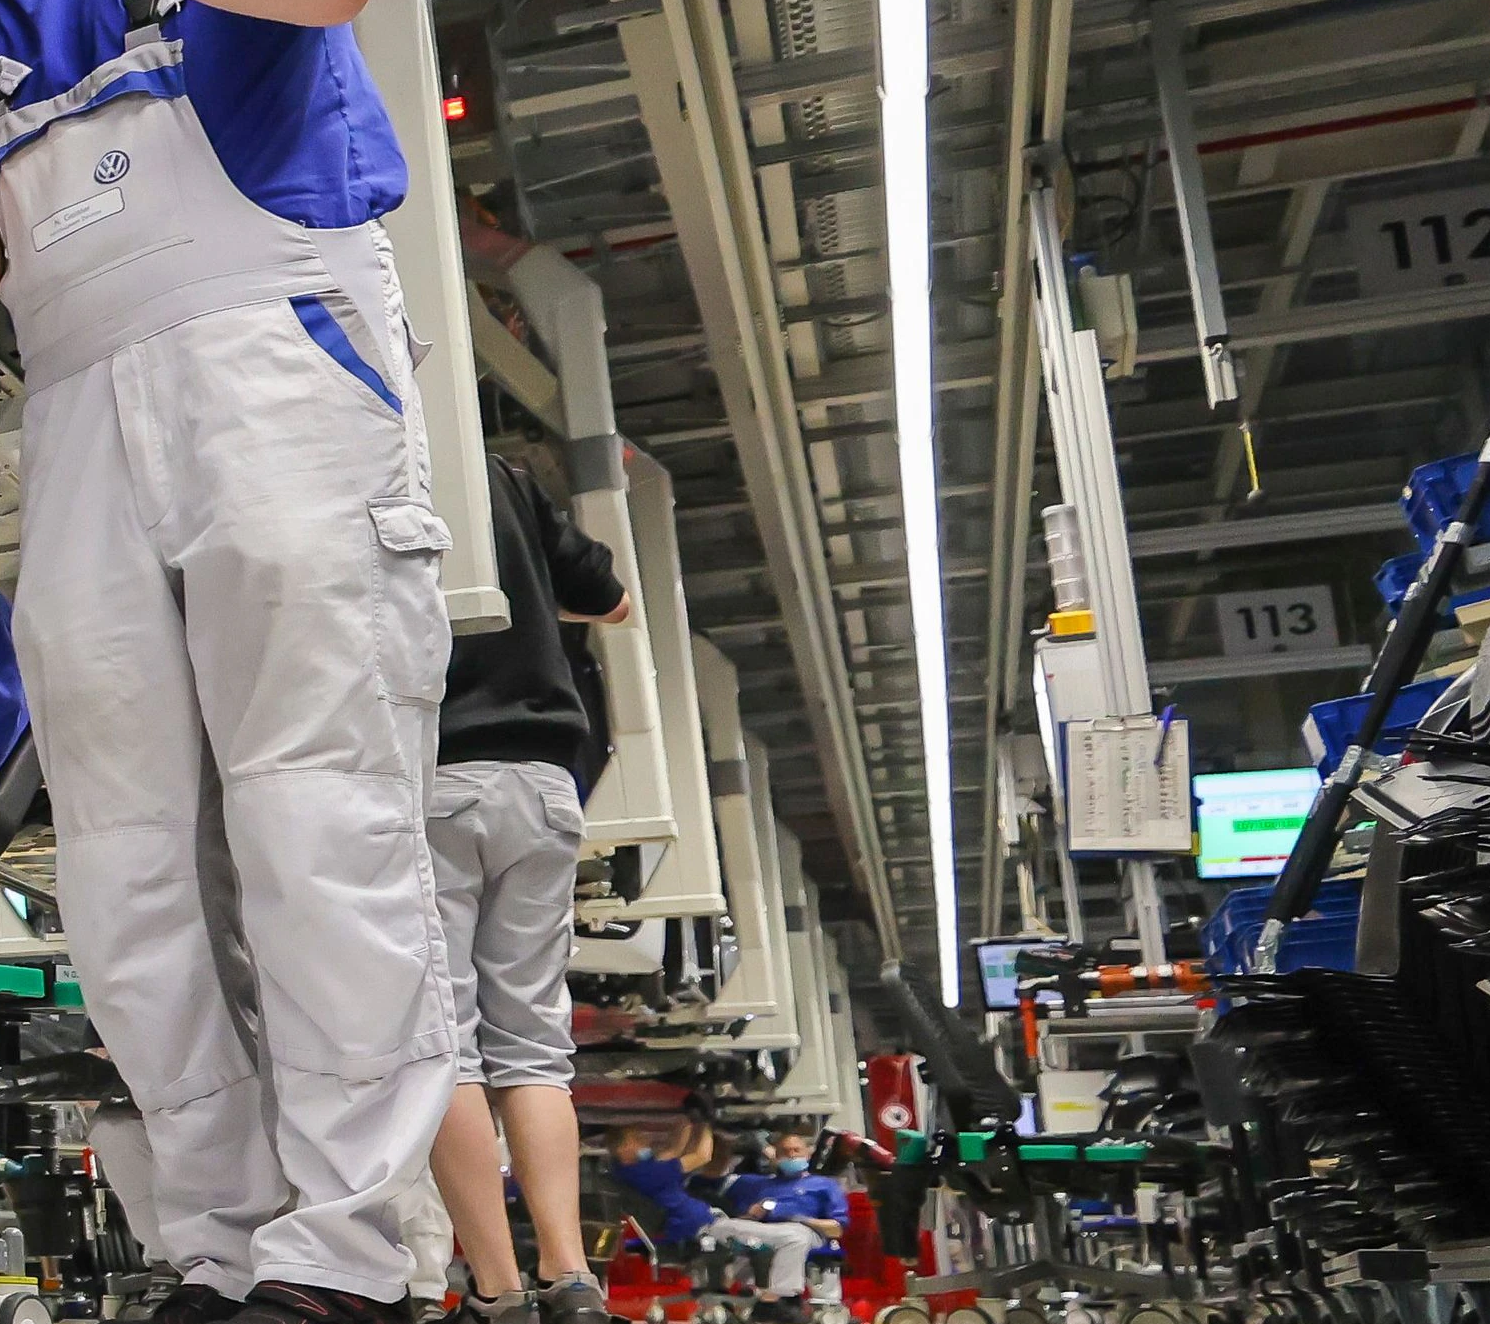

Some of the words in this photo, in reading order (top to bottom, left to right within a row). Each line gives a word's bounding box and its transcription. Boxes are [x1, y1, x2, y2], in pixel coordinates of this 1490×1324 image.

[95, 151, 129, 183] VW
[1379, 208, 1490, 270] 112
[1236, 603, 1317, 640] 113
